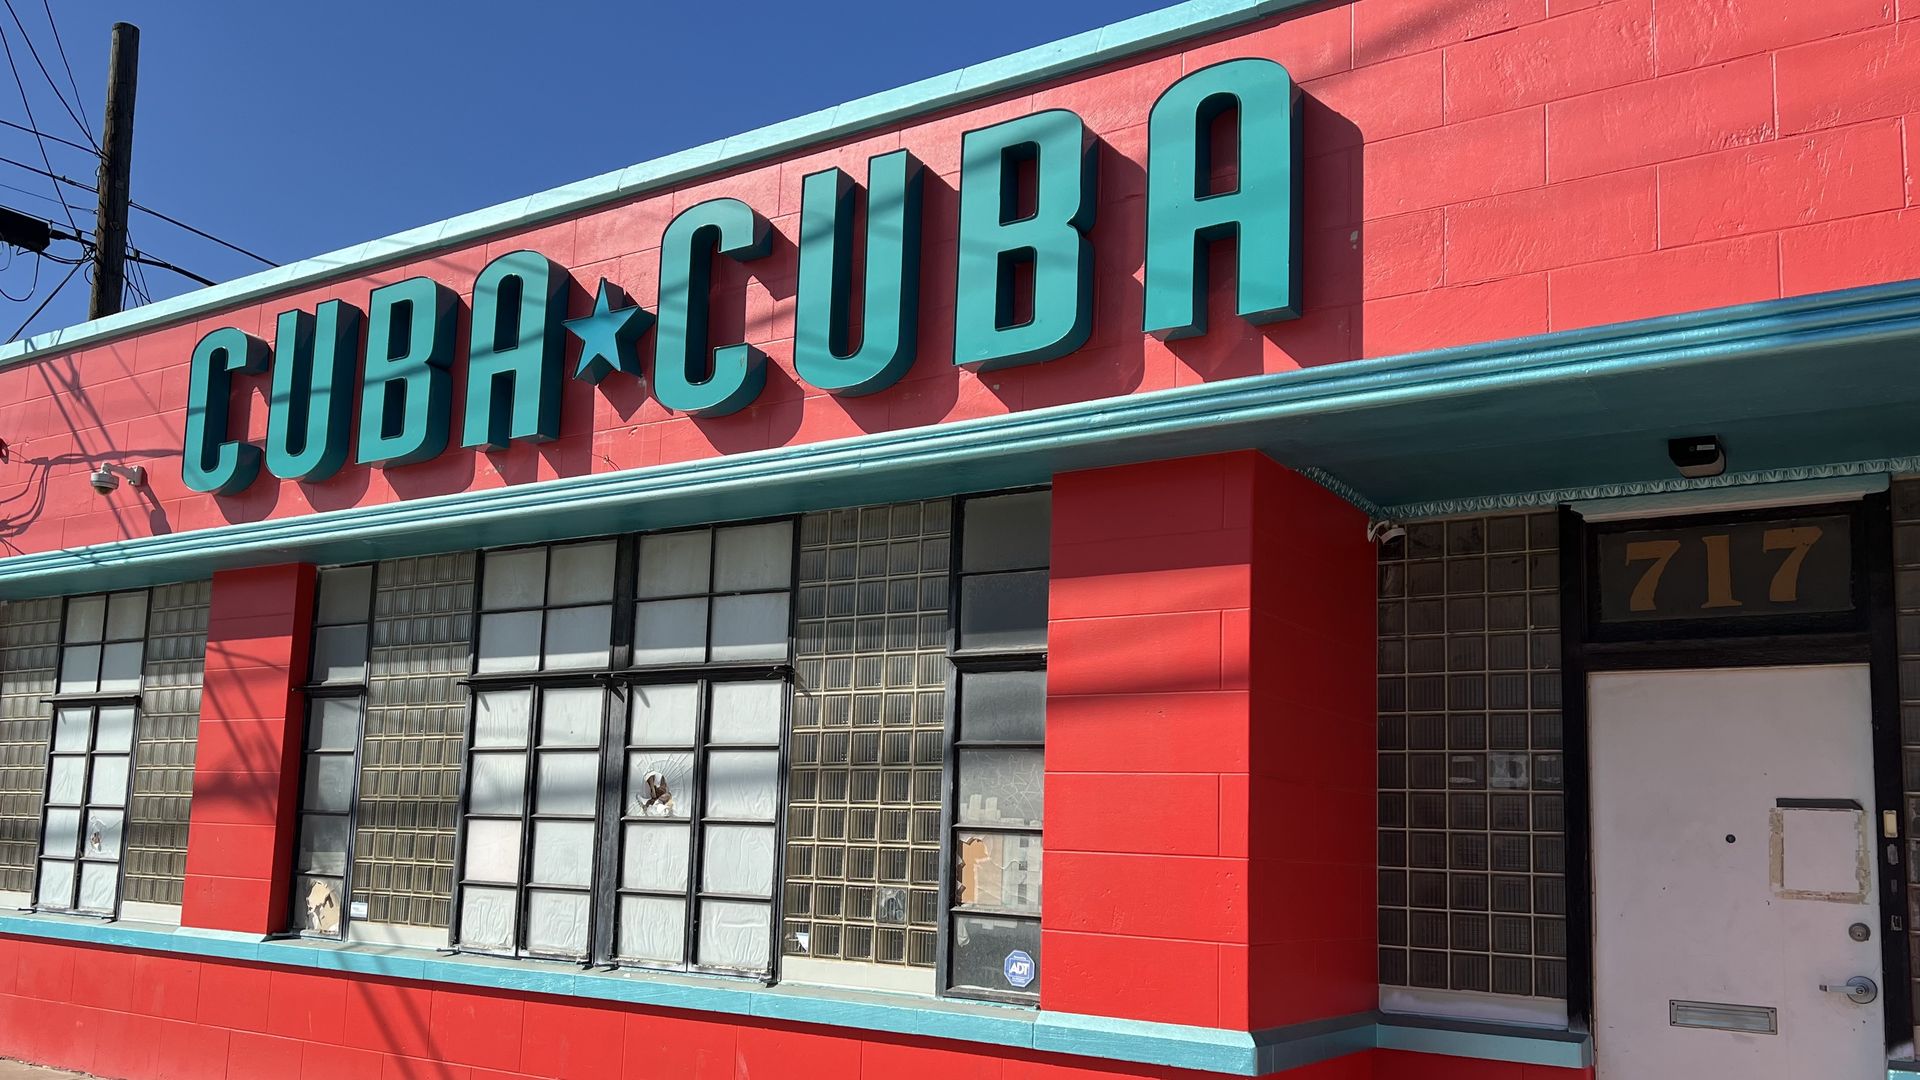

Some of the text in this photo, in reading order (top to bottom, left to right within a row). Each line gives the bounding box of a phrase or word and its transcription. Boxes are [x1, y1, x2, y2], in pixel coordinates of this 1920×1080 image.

[182, 57, 1301, 494] CUBA CUBA
[1625, 526, 1823, 611] 717
[1009, 961, 1030, 976] ADT
